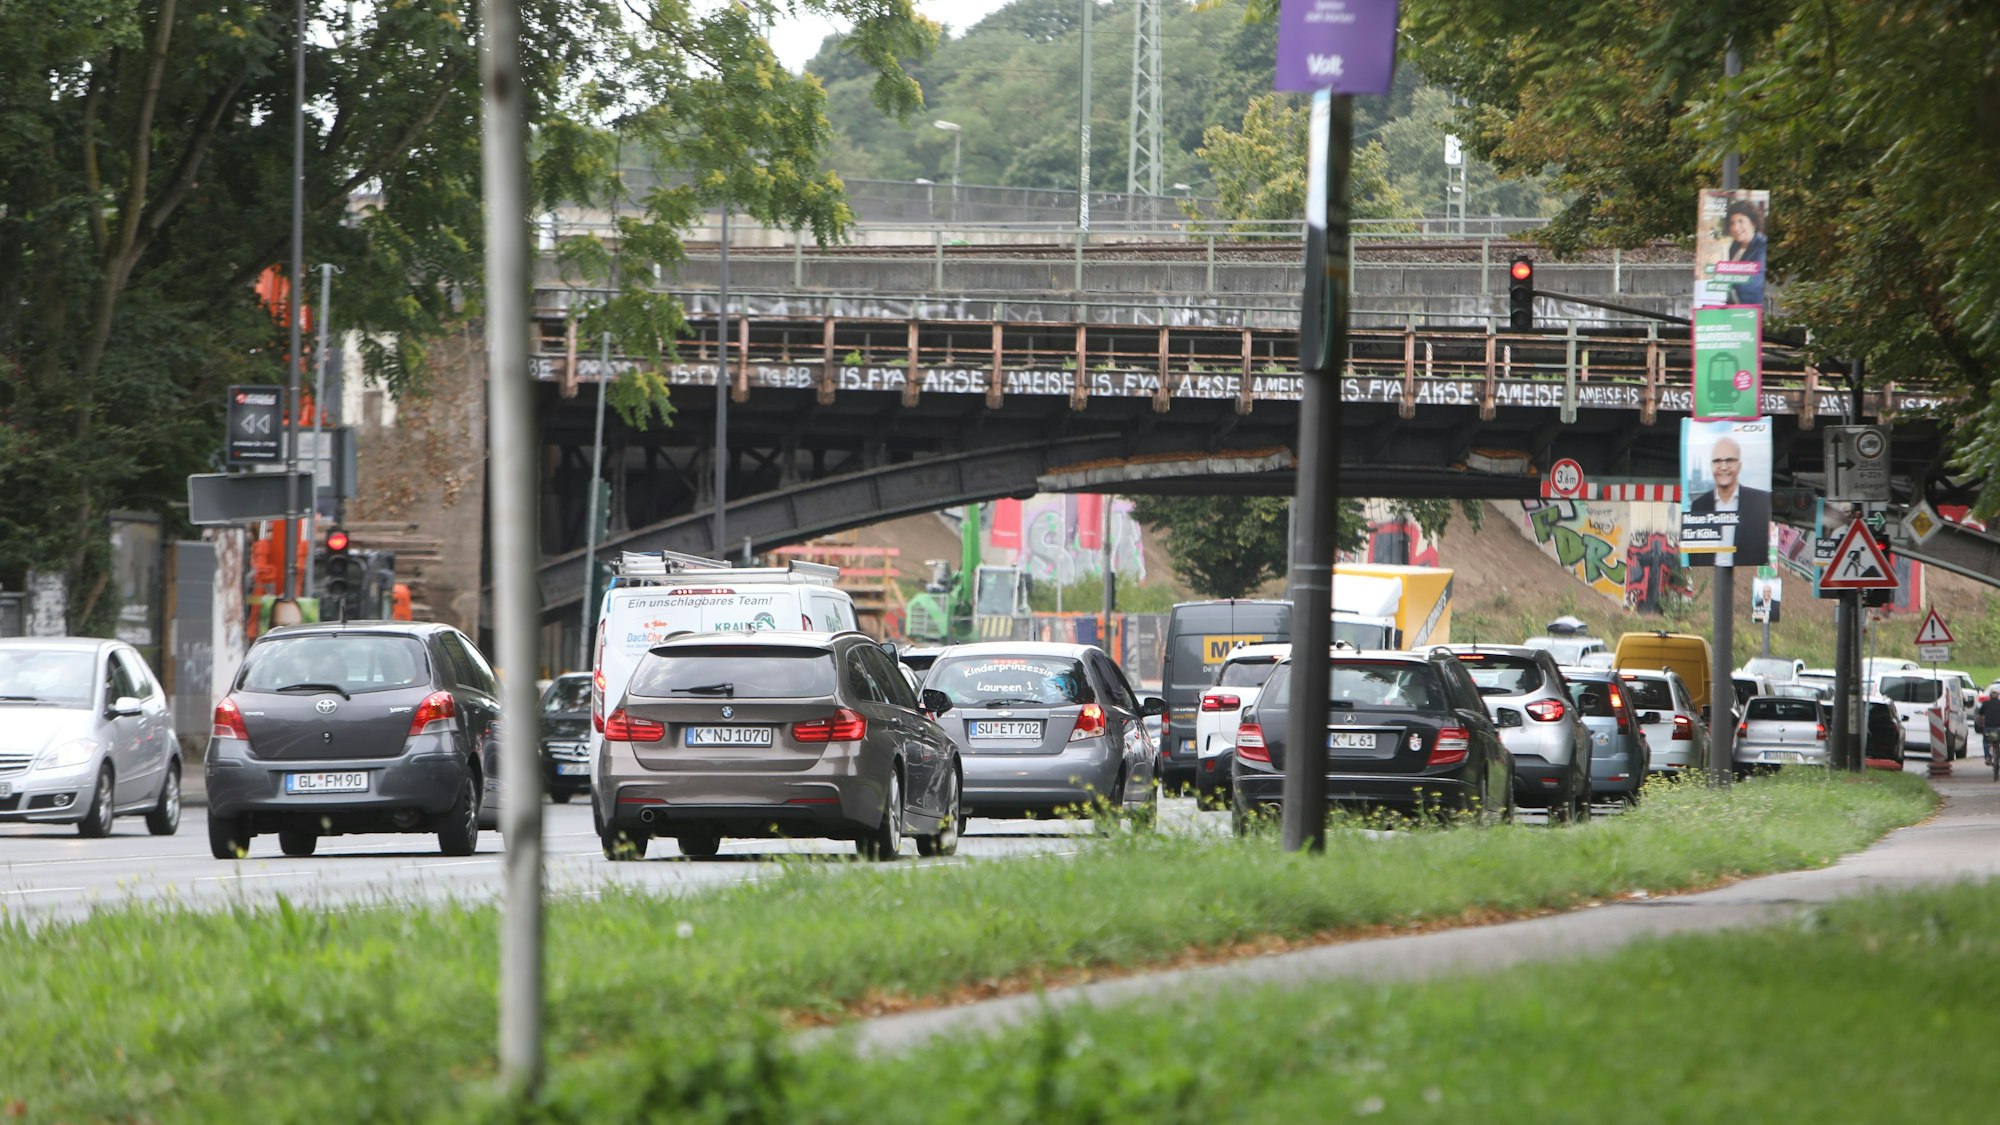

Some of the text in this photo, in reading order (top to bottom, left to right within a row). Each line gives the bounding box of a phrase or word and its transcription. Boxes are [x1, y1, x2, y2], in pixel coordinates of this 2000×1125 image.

[1306, 54, 1344, 76] Volt
[1003, 371, 1075, 394] AMEISE
[1496, 383, 1564, 406] AMEISE
[1683, 513, 1739, 524] Neue Politik
[1683, 528, 1721, 539] für Köln.
[1818, 539, 1835, 548] Kein
[628, 596, 773, 609] Ein unschlagbares Team!
[715, 622, 763, 631] KRAUSE
[963, 662, 1054, 678] Kinderprinzessin
[976, 681, 1022, 692] Laureen
[978, 723, 1039, 734] SU ET 702
[695, 728, 770, 743] K NJ 1070
[1332, 734, 1374, 747] K L 61
[299, 774, 361, 788] GL FM 90
